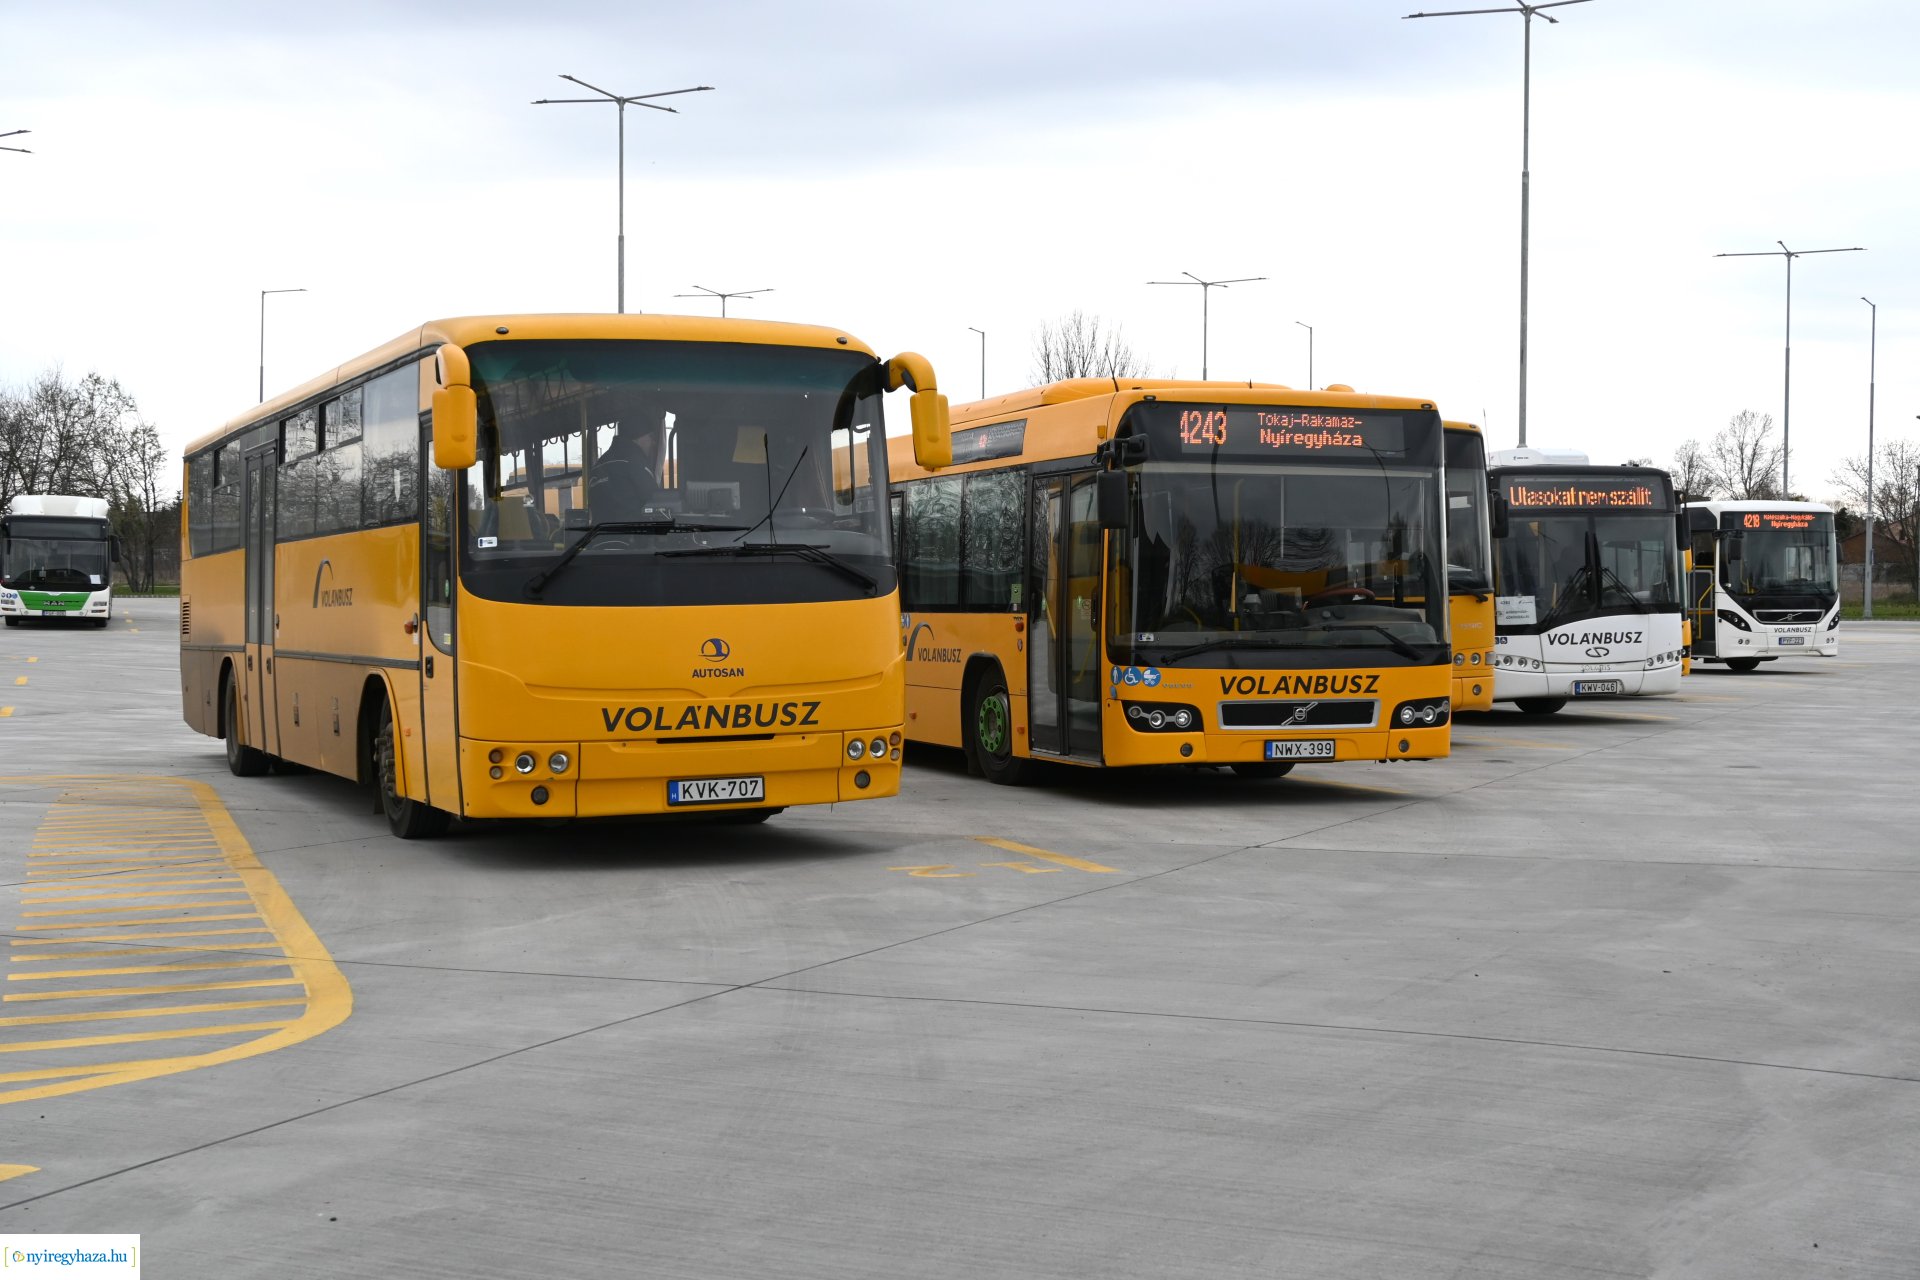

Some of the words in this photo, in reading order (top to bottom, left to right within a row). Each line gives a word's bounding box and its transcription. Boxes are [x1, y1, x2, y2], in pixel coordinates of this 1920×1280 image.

[1180, 410, 1227, 445] 4243
[1257, 412, 1362, 428] Tokaj-Rakamaz-
[1260, 428, 1363, 449] Nyíregyháza
[1743, 513, 1760, 528] 4218
[1547, 631, 1643, 646] VOLÁNBUSZ
[692, 667, 745, 678] AUTOSAN
[1220, 674, 1380, 695] VOLÁNBUSZ
[1581, 683, 1615, 692] KWV-046
[601, 701, 821, 732] VOLÁNBUSZ
[1275, 742, 1332, 756] NWX-399
[682, 780, 759, 799] KVK-707
